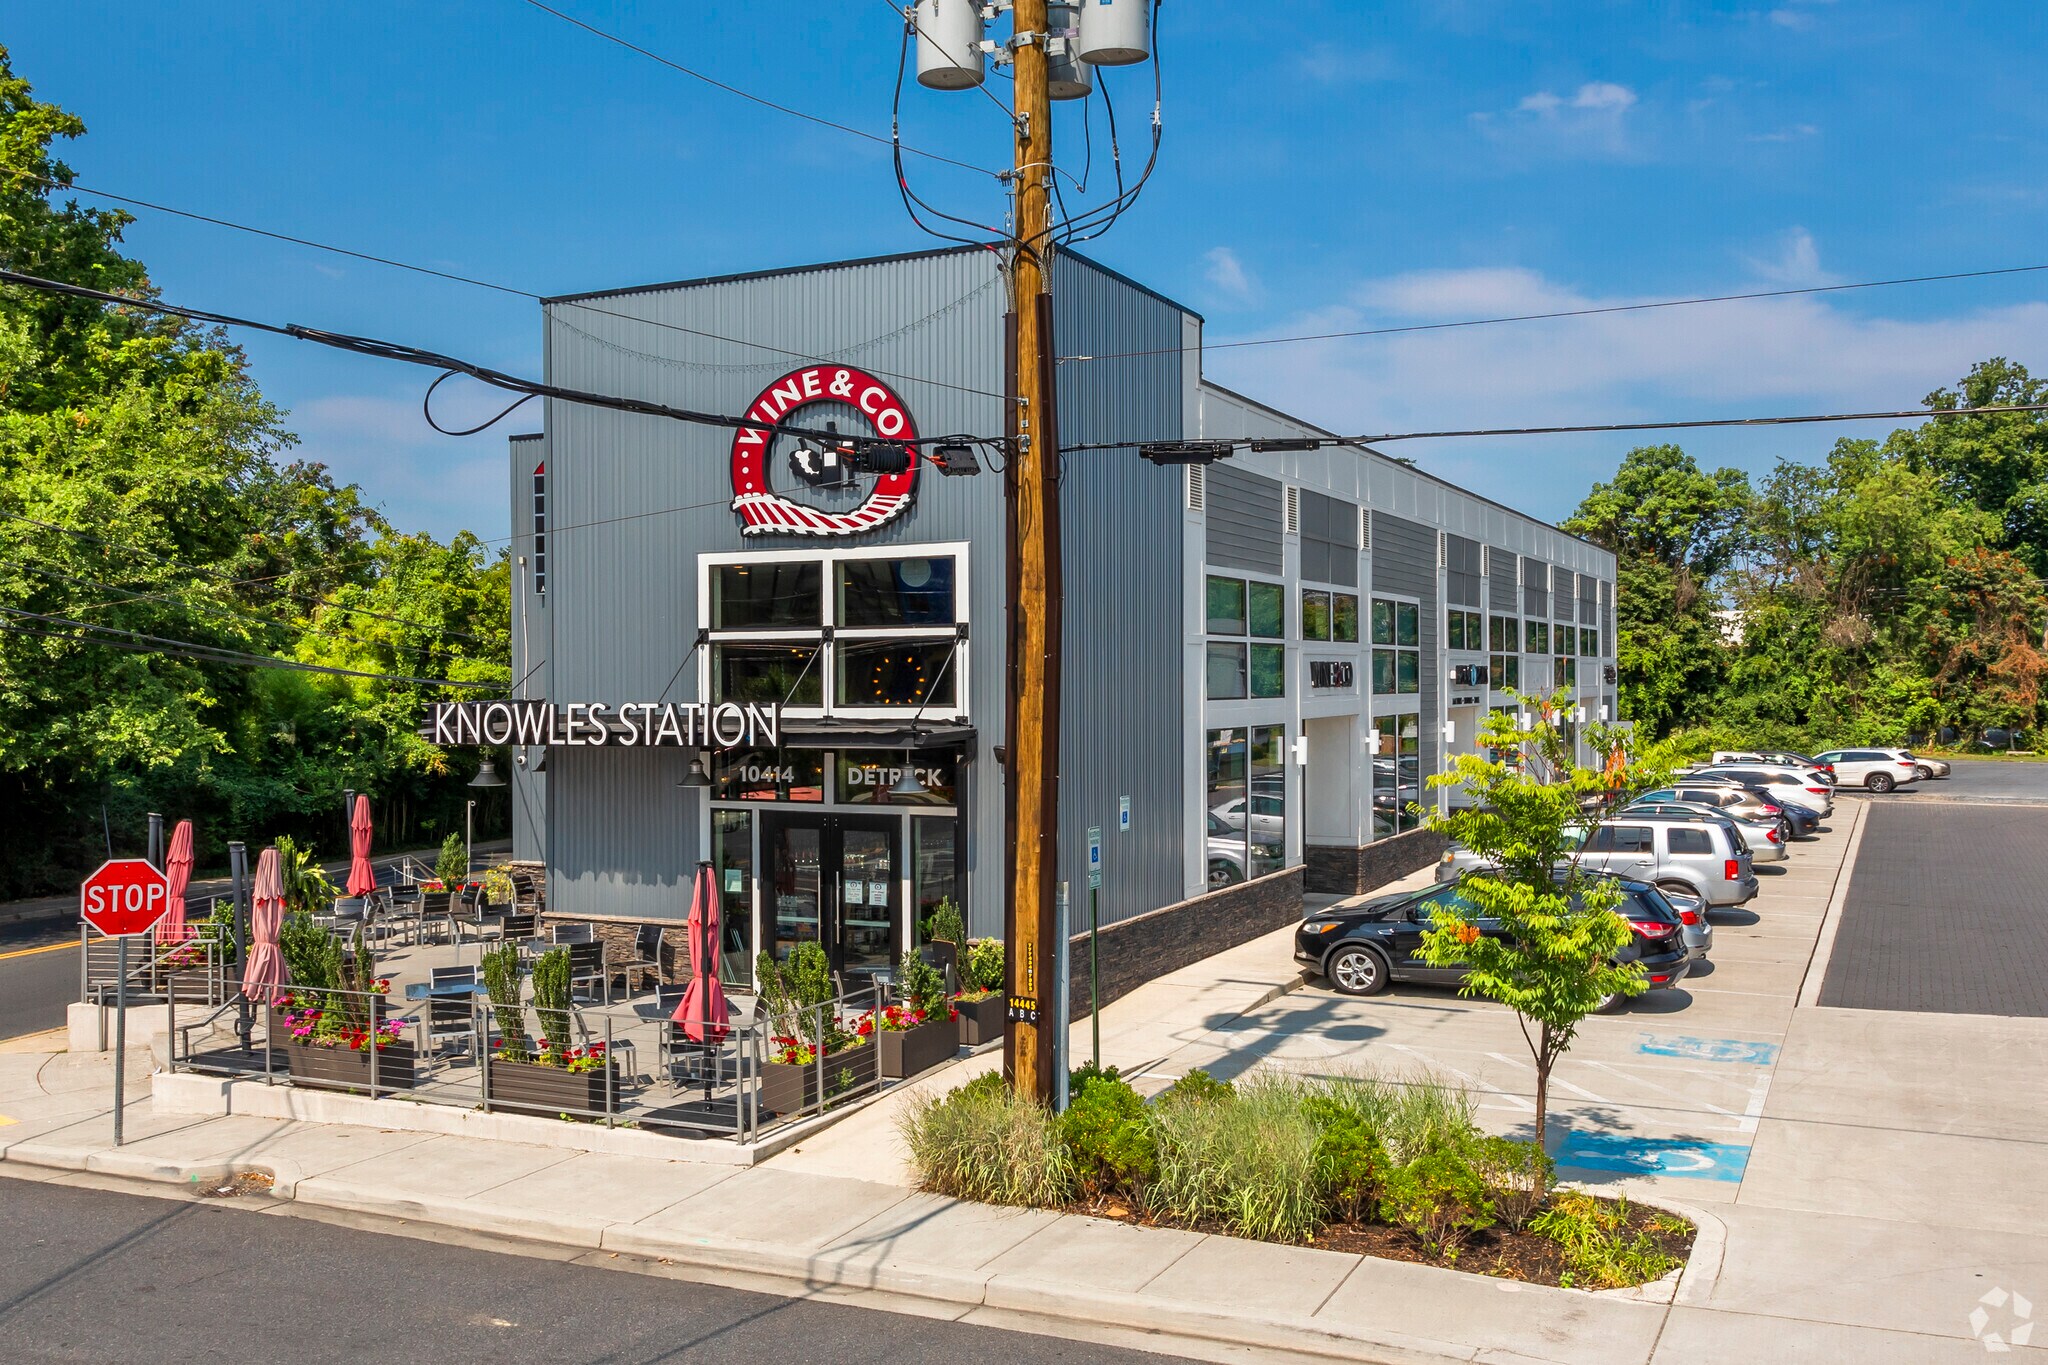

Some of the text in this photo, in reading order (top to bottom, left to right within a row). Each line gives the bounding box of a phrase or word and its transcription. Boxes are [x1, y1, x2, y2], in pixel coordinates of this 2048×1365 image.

[829, 369, 855, 398] &
[860, 386, 904, 436] CO
[435, 702, 777, 747] KNOWLES STATION
[739, 765, 795, 783] 10414
[847, 767, 942, 787] DETRCK
[87, 883, 165, 914] STOP
[1008, 1007, 1036, 1020] A B C
[1009, 998, 1036, 1011] 14445
